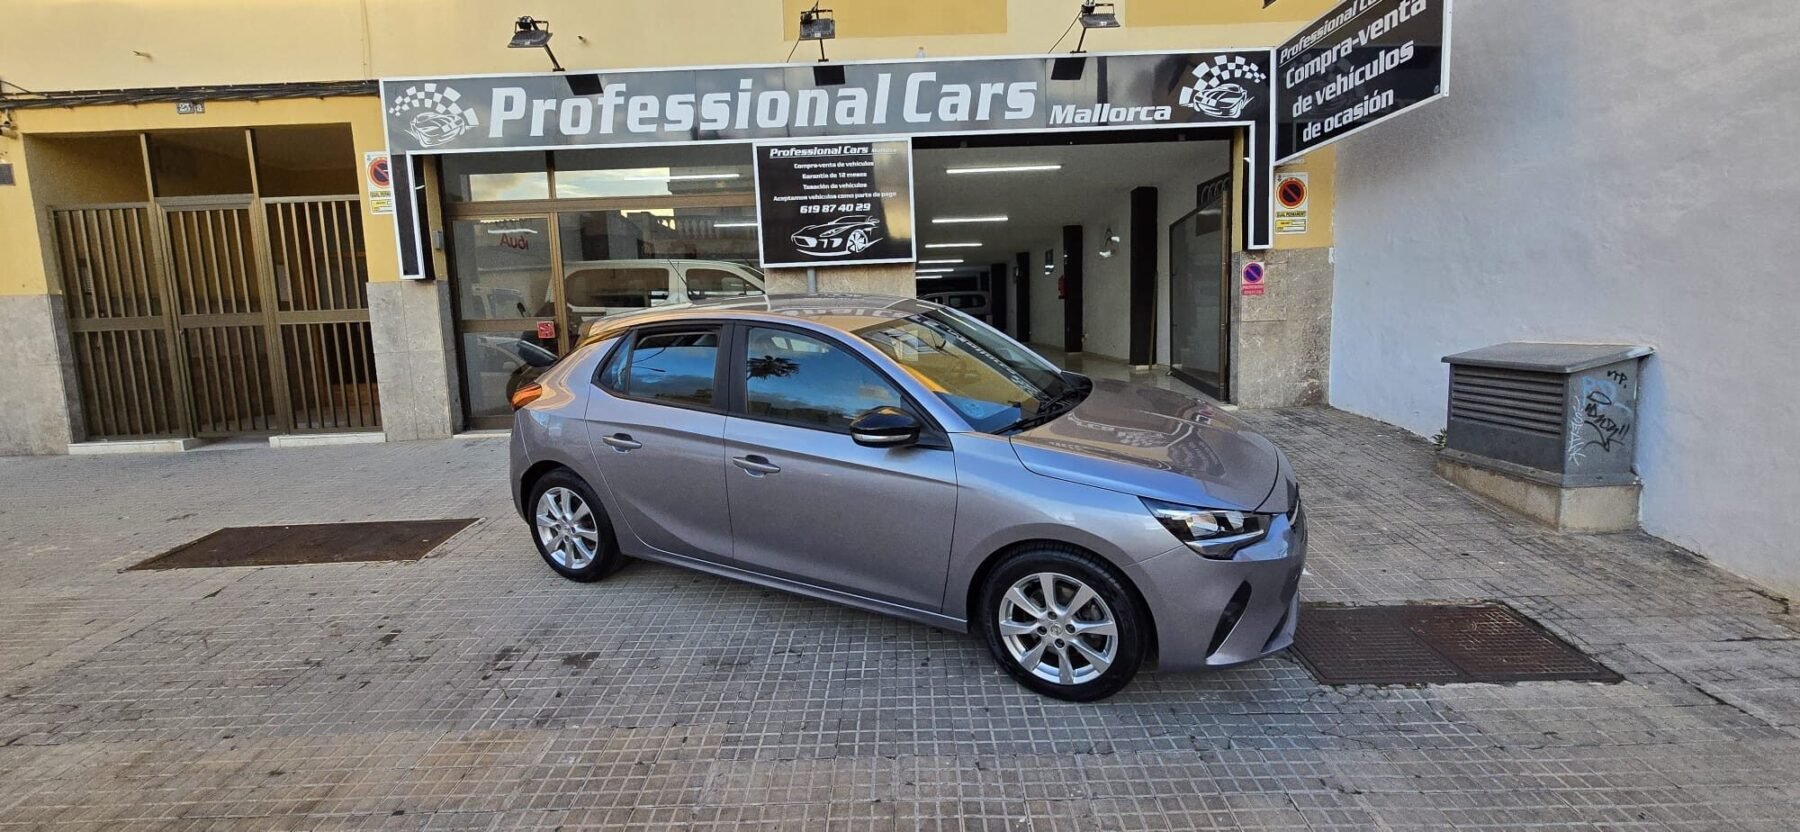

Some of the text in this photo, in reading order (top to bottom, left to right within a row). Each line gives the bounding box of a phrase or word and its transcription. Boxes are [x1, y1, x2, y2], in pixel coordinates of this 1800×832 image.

[1286, 0, 1427, 89] Compra-venta
[1292, 40, 1414, 118] de vehículos
[488, 71, 1172, 138] Professional Cars Mallorca
[1302, 88, 1394, 143] de ocasión
[769, 146, 842, 157] Professional
[843, 145, 869, 155] Cars
[793, 161, 836, 169] Compra-venta
[837, 160, 845, 168] de
[800, 202, 871, 214] 619 87 40 29
[855, 192, 872, 200] parte
